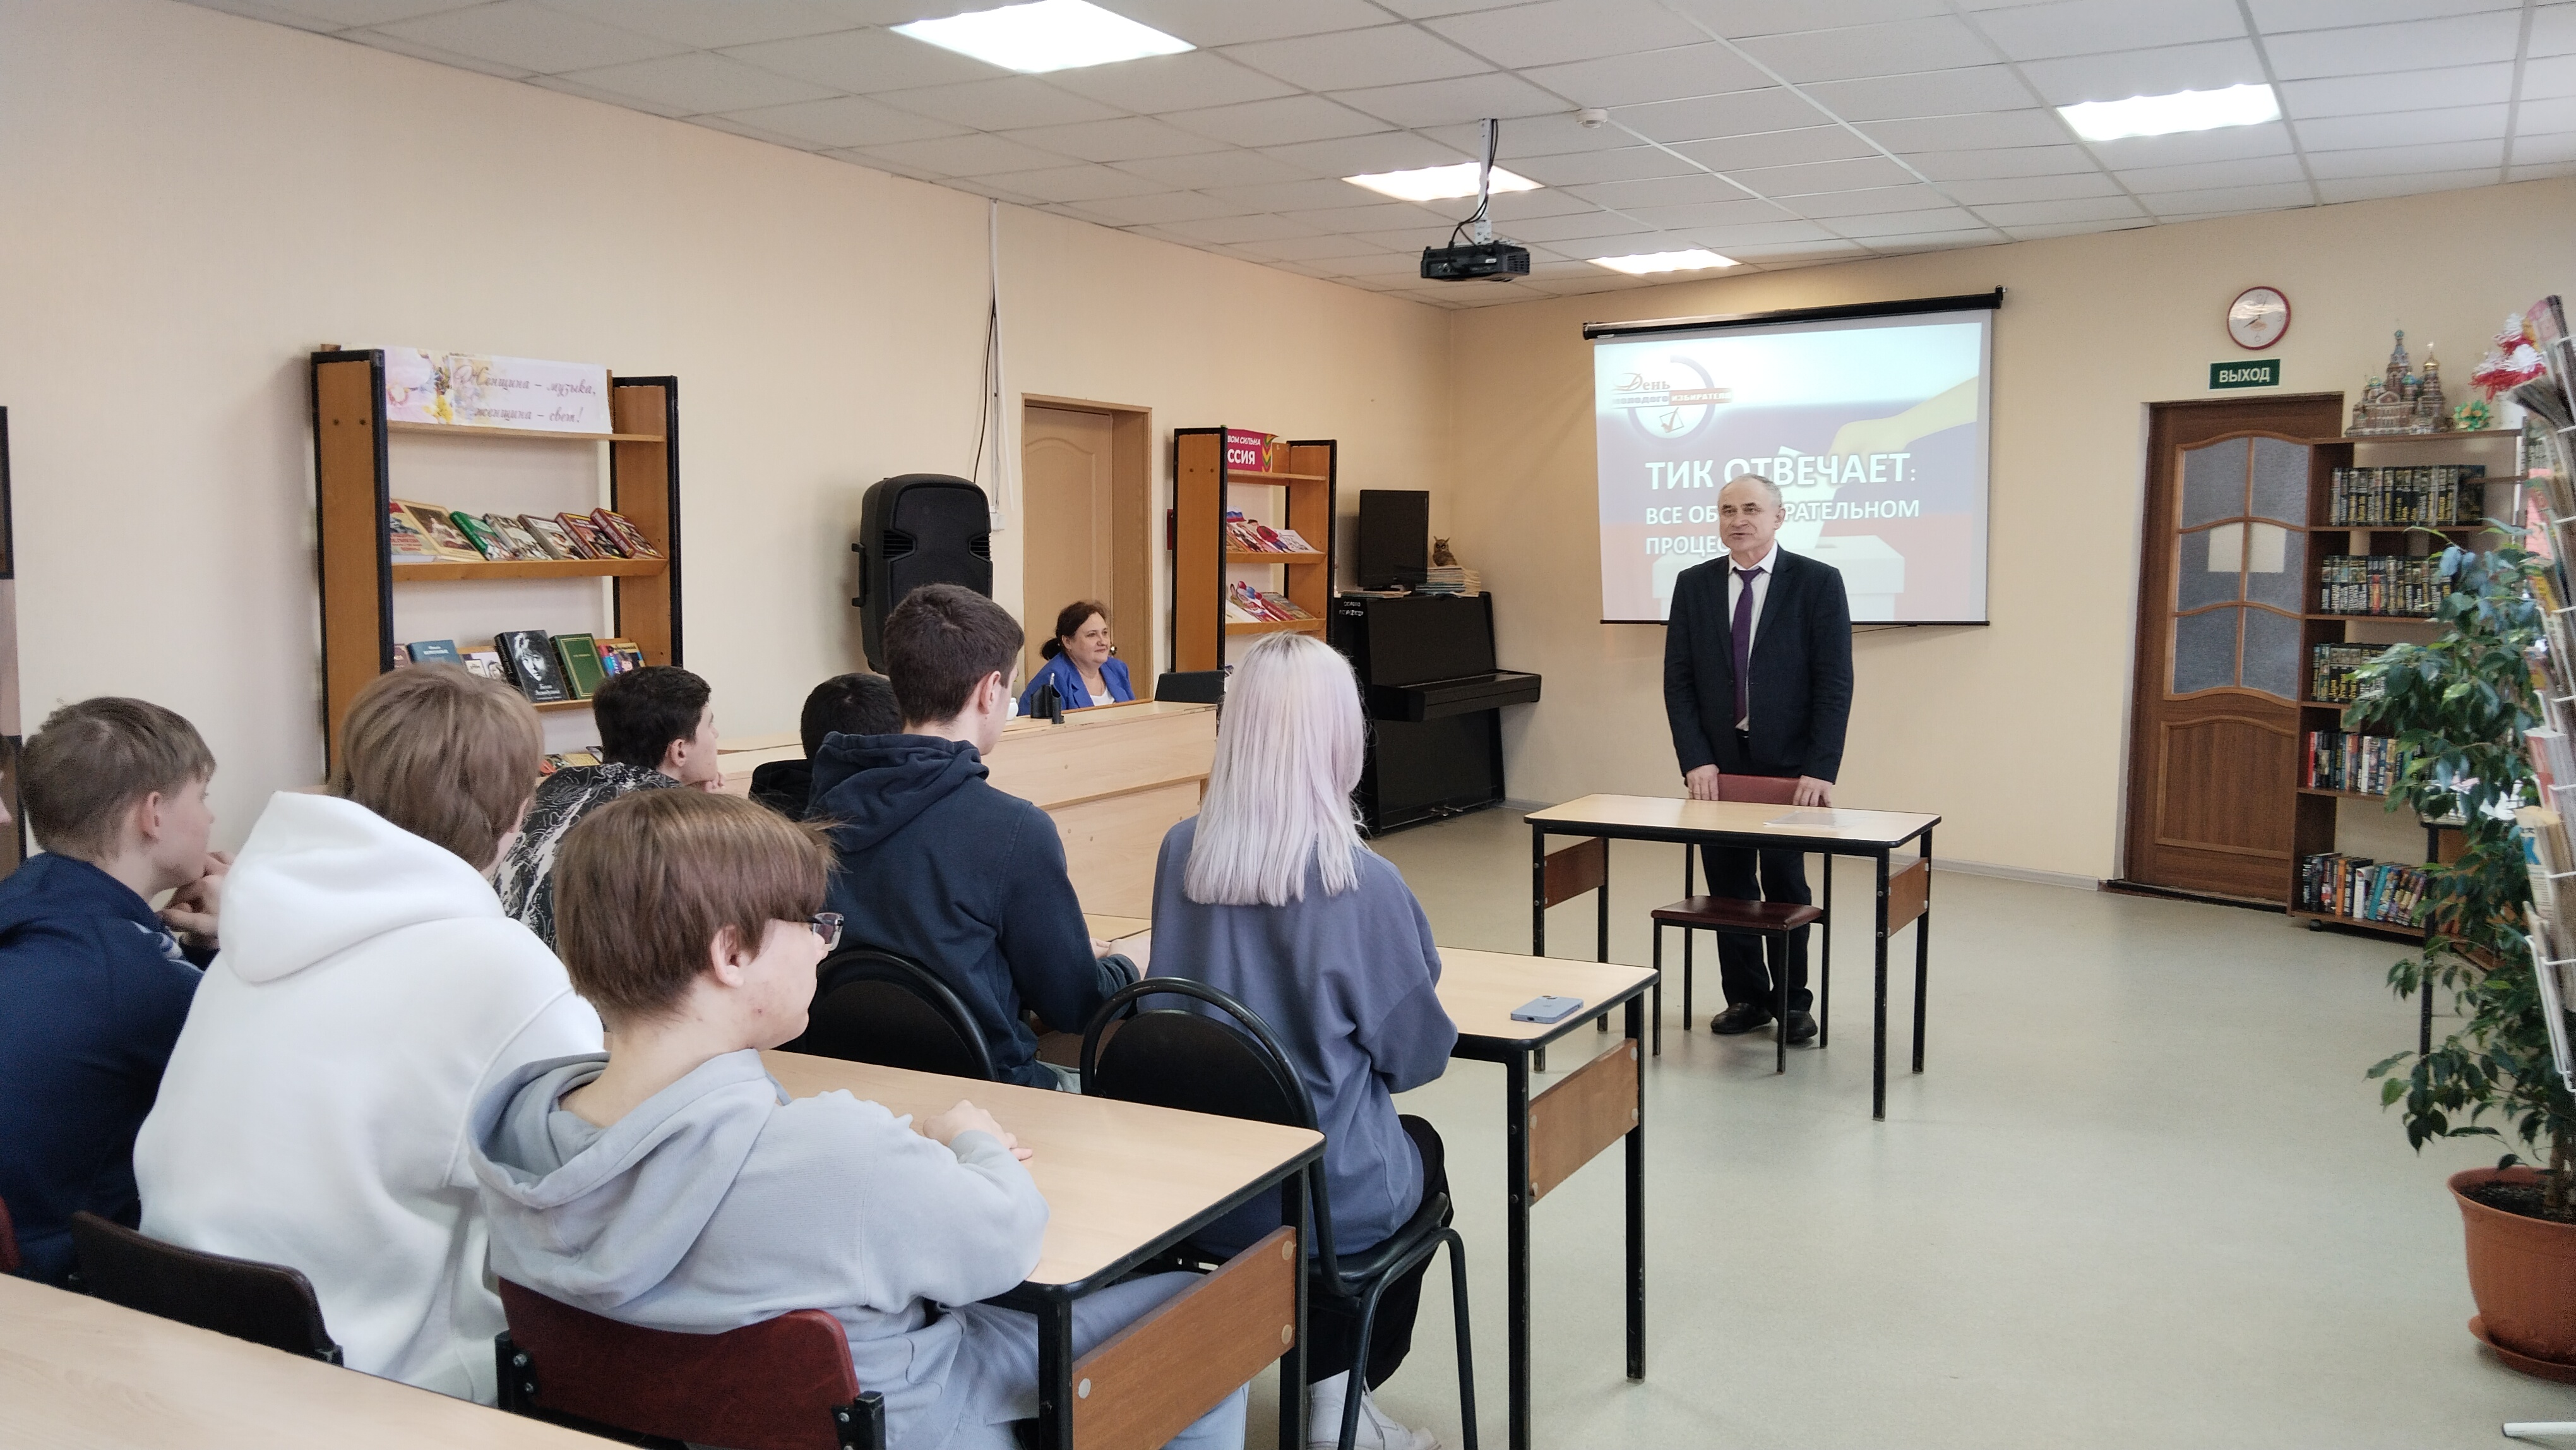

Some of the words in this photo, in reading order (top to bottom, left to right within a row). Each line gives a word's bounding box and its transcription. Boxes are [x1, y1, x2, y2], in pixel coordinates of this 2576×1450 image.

[1611, 372, 1671, 392] День
[2219, 367, 2270, 383] ВЫХОД
[546, 379, 596, 397] музыка,
[474, 407, 532, 422] женщина
[549, 407, 584, 423] свет!
[1239, 436, 1261, 446] СИЛЬНА
[1227, 448, 1255, 465] ССИЯ
[1645, 459, 1714, 490] ТИК
[1724, 453, 1916, 486] ОТВЕЧАЕТ:
[1645, 506, 1683, 525] ВСЕ
[1688, 505, 1719, 524] ОБ
[1784, 499, 1920, 522] РАТЕЛЬНОМ
[1645, 535, 1731, 558] ПРОЦЕС
